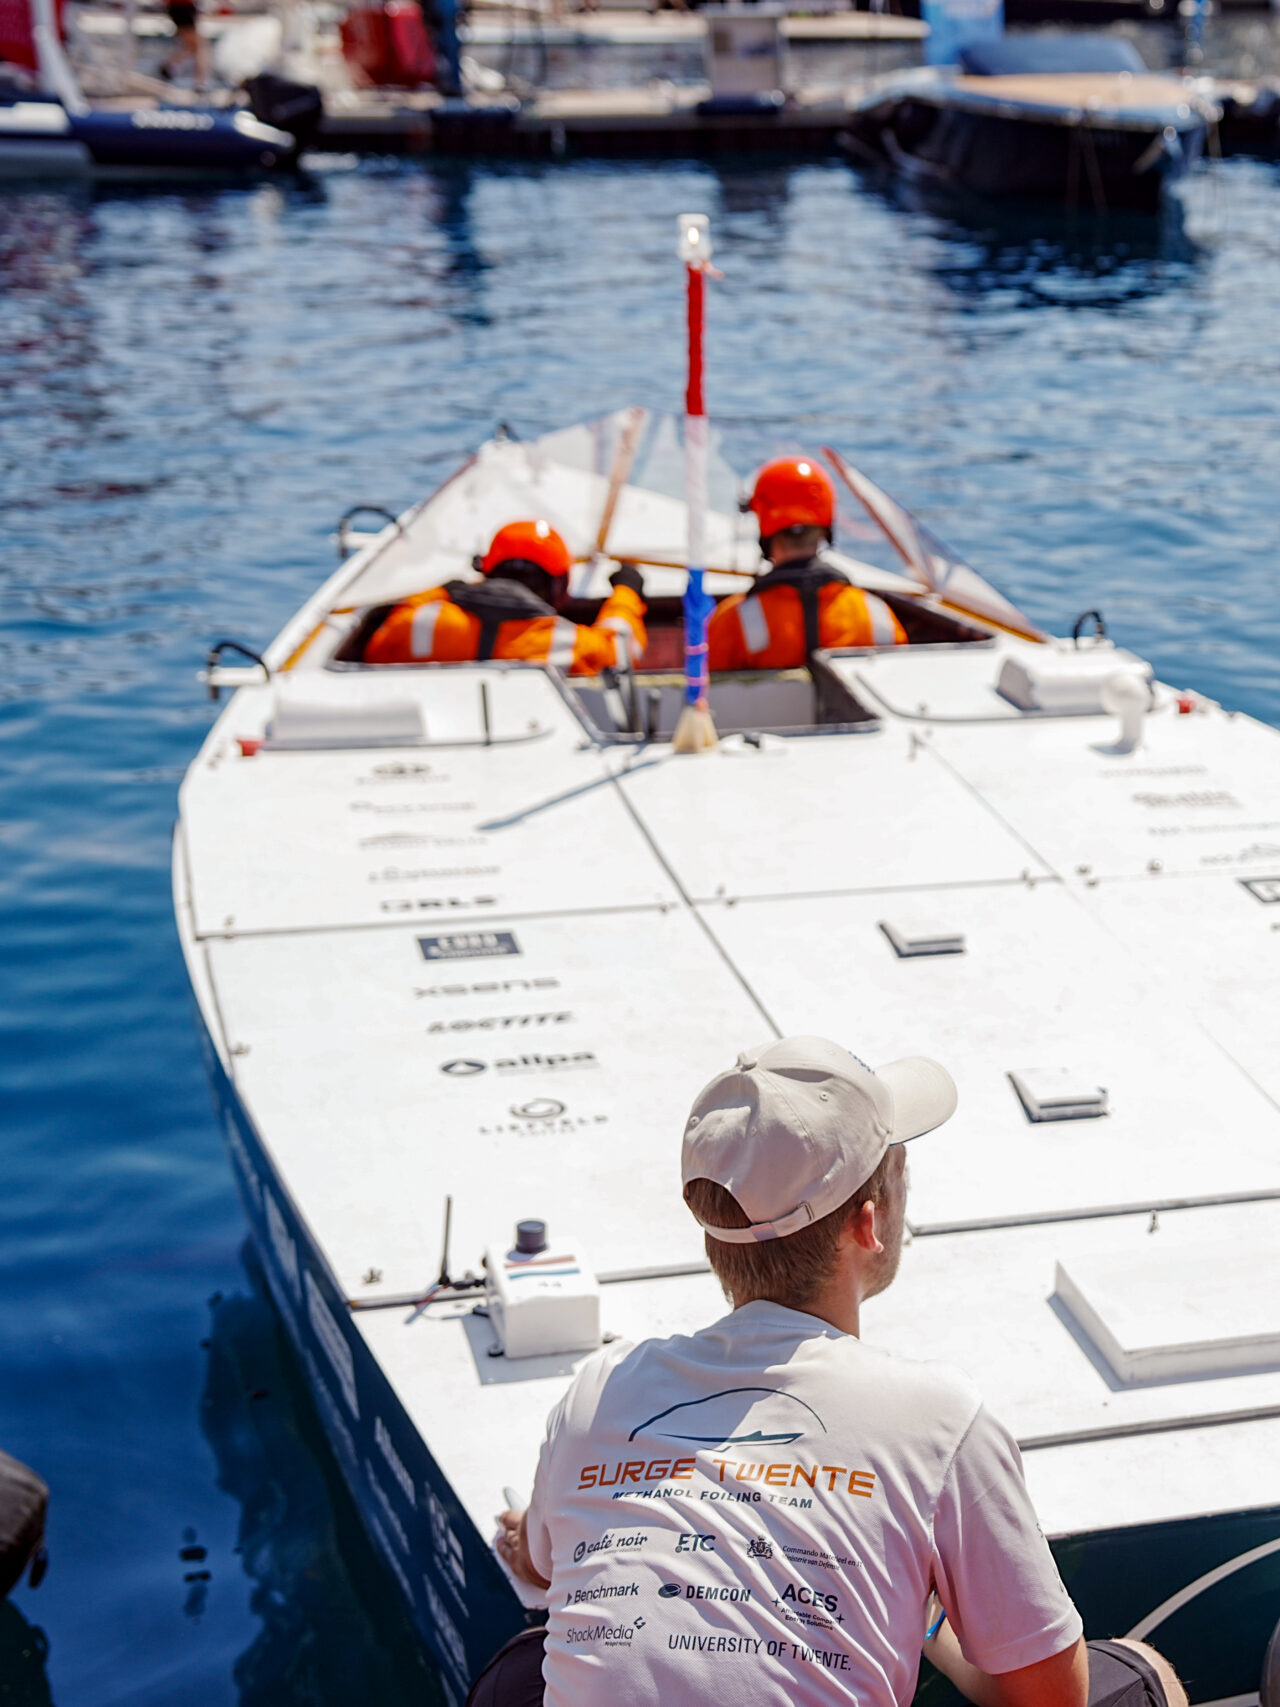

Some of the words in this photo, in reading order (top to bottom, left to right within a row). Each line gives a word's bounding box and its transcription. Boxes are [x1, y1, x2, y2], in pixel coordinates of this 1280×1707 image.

[577, 1458, 696, 1490] SURGE
[713, 1459, 876, 1498] TWENTE
[612, 1488, 694, 1501] METHANOL
[700, 1490, 761, 1503] FOILING
[767, 1494, 812, 1508] TEAM
[587, 1533, 614, 1554] café
[616, 1532, 648, 1548] noir
[675, 1533, 715, 1553] ETC
[782, 1545, 819, 1557] Commando
[574, 1582, 639, 1604] Benchmark
[686, 1585, 751, 1602] DEMCON
[781, 1583, 838, 1612] ACES
[668, 1634, 762, 1655] UNIVERSITY
[766, 1640, 788, 1657] OF
[791, 1643, 852, 1672] TWENTE.
